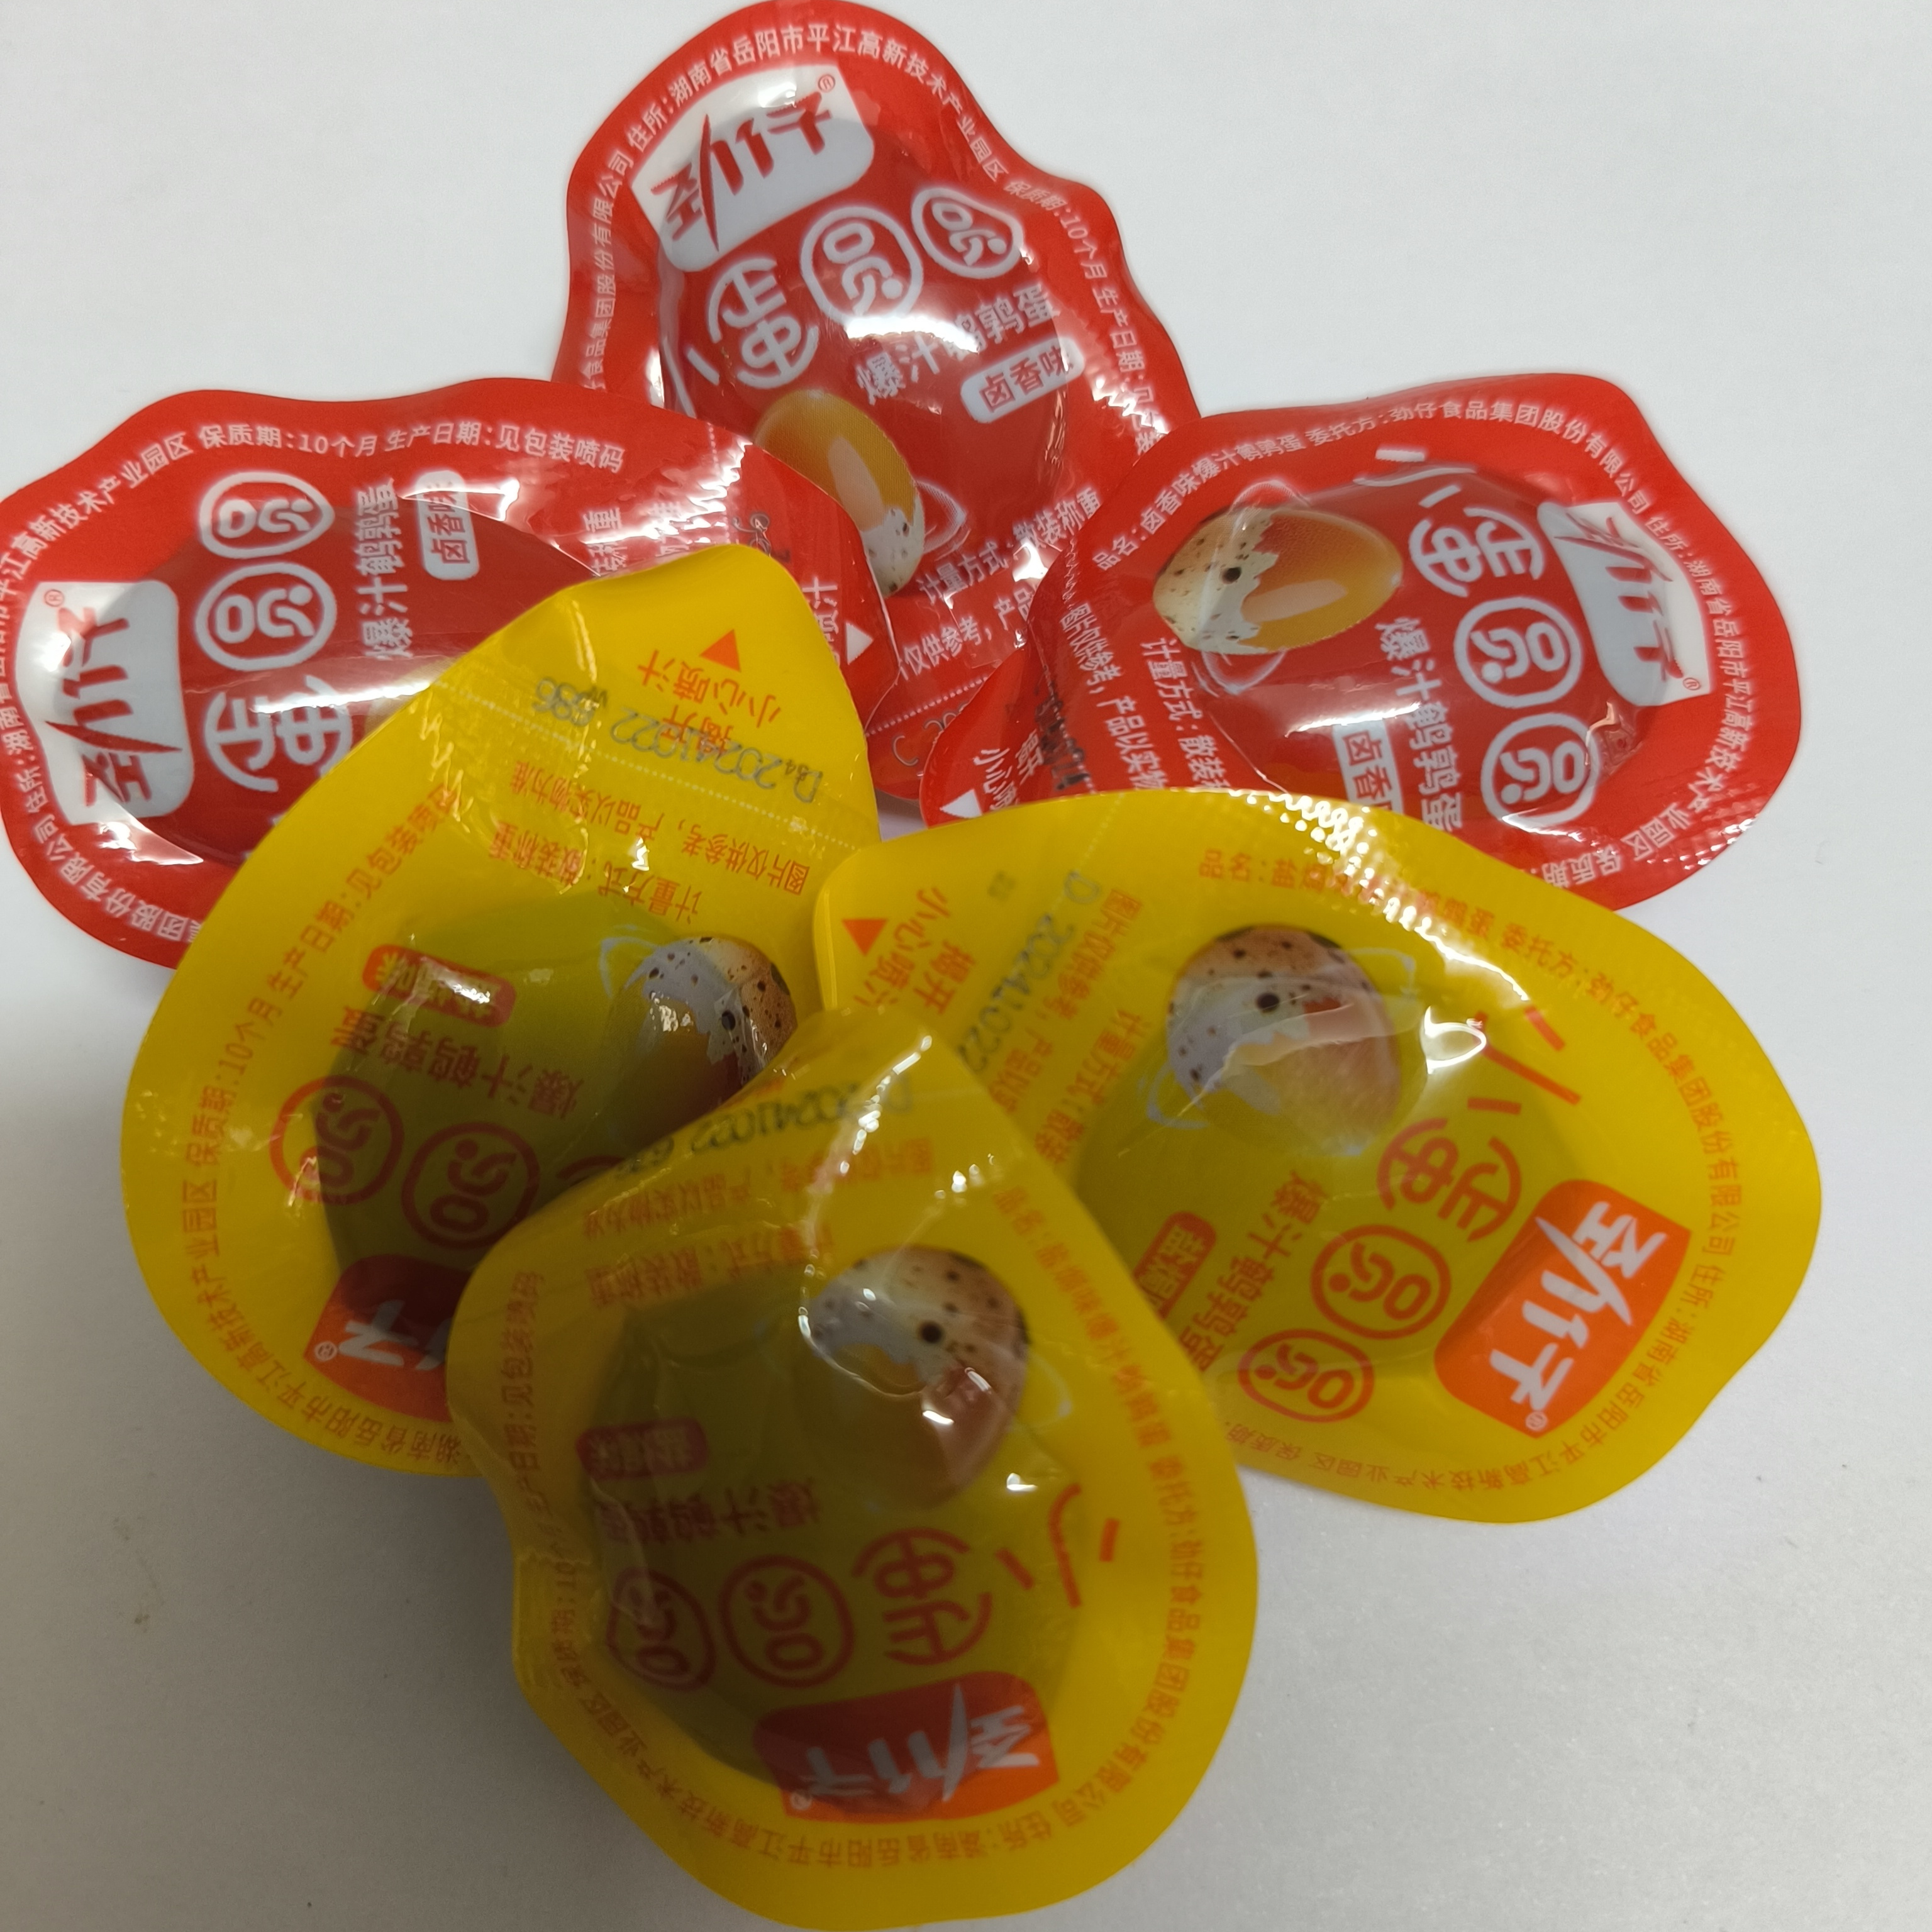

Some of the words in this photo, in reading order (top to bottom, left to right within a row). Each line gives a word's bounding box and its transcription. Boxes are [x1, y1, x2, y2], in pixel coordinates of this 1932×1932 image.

[979, 346, 1074, 413] 卤香味
[198, 423, 378, 458] 保质期:10个月
[384, 421, 625, 473] 生产日期:见包装喷码
[1305, 400, 1651, 515] 委托方:劲仔食品集团股份有限公司
[1092, 433, 1306, 570] 品名:卤香味爆汁鹌鹑蛋
[354, 477, 414, 660] 爆汁鹌鹑蛋
[636, 648, 782, 729] 小心喷汁
[510, 761, 811, 896] 图片仅供参考，产品以实物为准
[1341, 731, 1401, 814] 卤香
[186, 996, 284, 1168] 保质期:10个月
[1489, 1201, 1669, 1413] 劲仔
